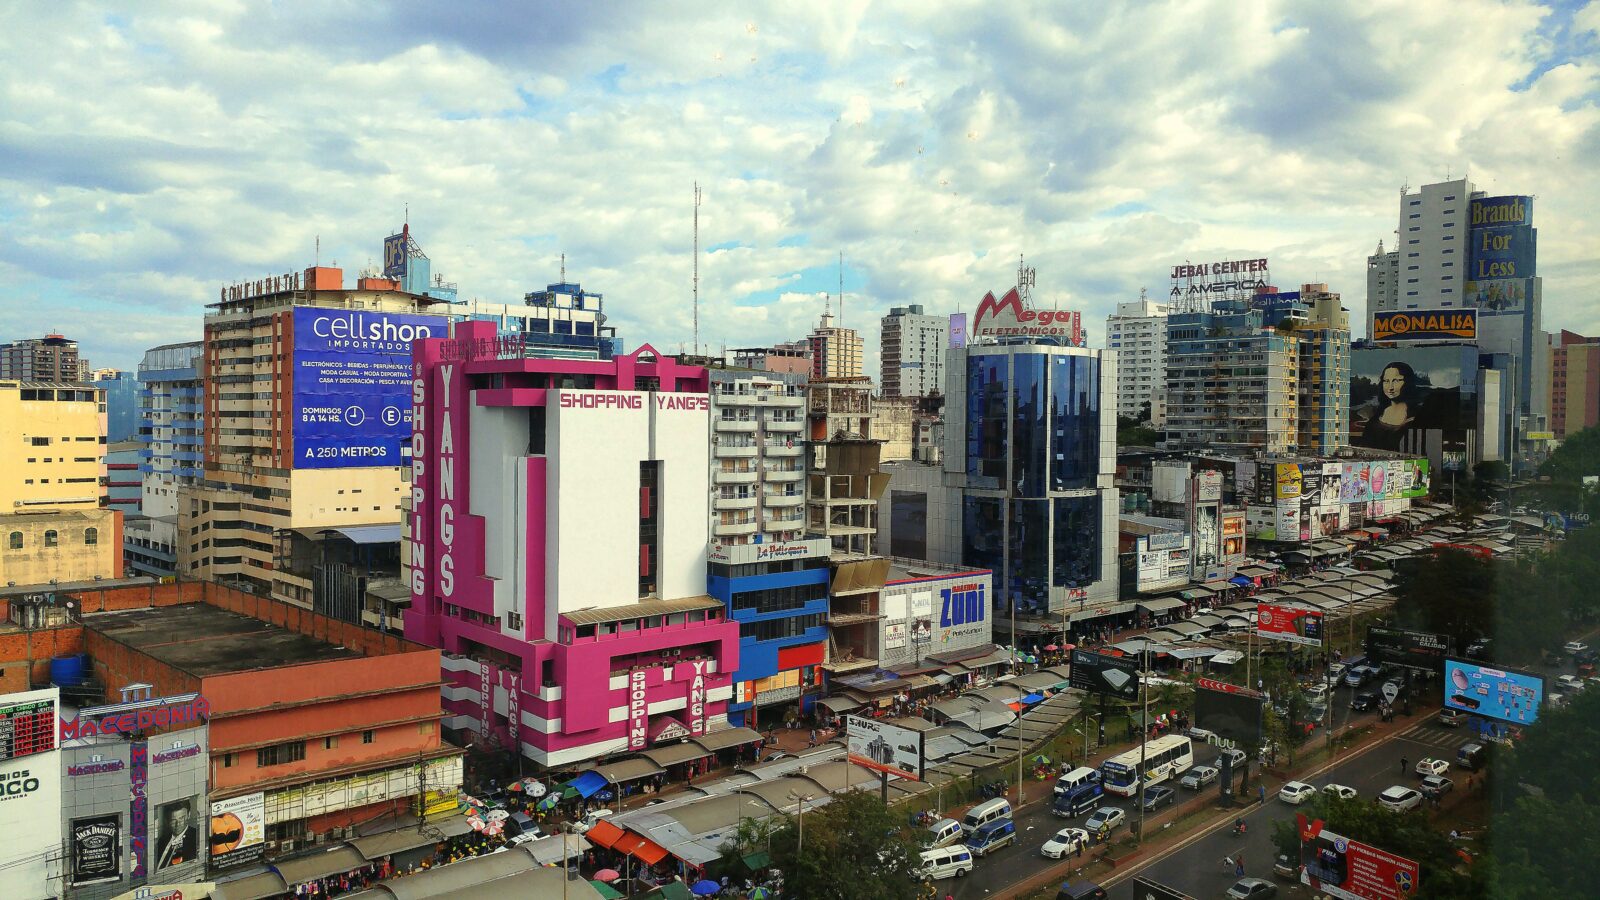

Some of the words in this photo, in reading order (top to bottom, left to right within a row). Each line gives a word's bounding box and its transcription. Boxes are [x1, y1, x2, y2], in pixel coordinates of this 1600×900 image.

[1471, 200, 1525, 225] Brands
[1482, 230, 1513, 251] For
[385, 237, 404, 268] DFS
[1171, 264, 1209, 279] JEBAI
[1212, 258, 1268, 275] CENTER
[1478, 258, 1516, 278] Less
[1188, 278, 1268, 295] AMERICA
[972, 286, 1071, 339] Mega
[982, 326, 1065, 335] ELETRÔNICOS
[1374, 314, 1475, 333] MONALISA
[328, 340, 410, 350] IMPORTADOS
[302, 360, 343, 368] ELECTRÓNICOS
[302, 407, 342, 415] DOMINGOS
[560, 393, 642, 409] SHOPPING
[656, 394, 709, 411] YANG'S
[302, 414, 309, 422] 8
[309, 414, 316, 422] A
[317, 414, 327, 422] 14
[387, 410, 395, 421] E
[305, 448, 314, 458] A
[317, 447, 338, 457] 250
[340, 446, 387, 457] METROS
[412, 379, 425, 596] SHOPPING
[939, 583, 985, 628] Zuni
[1419, 641, 1447, 650] CALIDAD
[481, 664, 490, 738] SHOPPING
[631, 672, 645, 748] SHOPPING
[60, 696, 210, 741] MACEDONIA
[848, 717, 880, 732] SHURE
[152, 743, 202, 765] MACEDONIA
[67, 759, 125, 777] MACEDONIA
[131, 748, 147, 880] MACEDONIA
[76, 829, 92, 841] JACK
[91, 825, 116, 837] DANIEL'S
[1396, 861, 1413, 871] JUEGO
